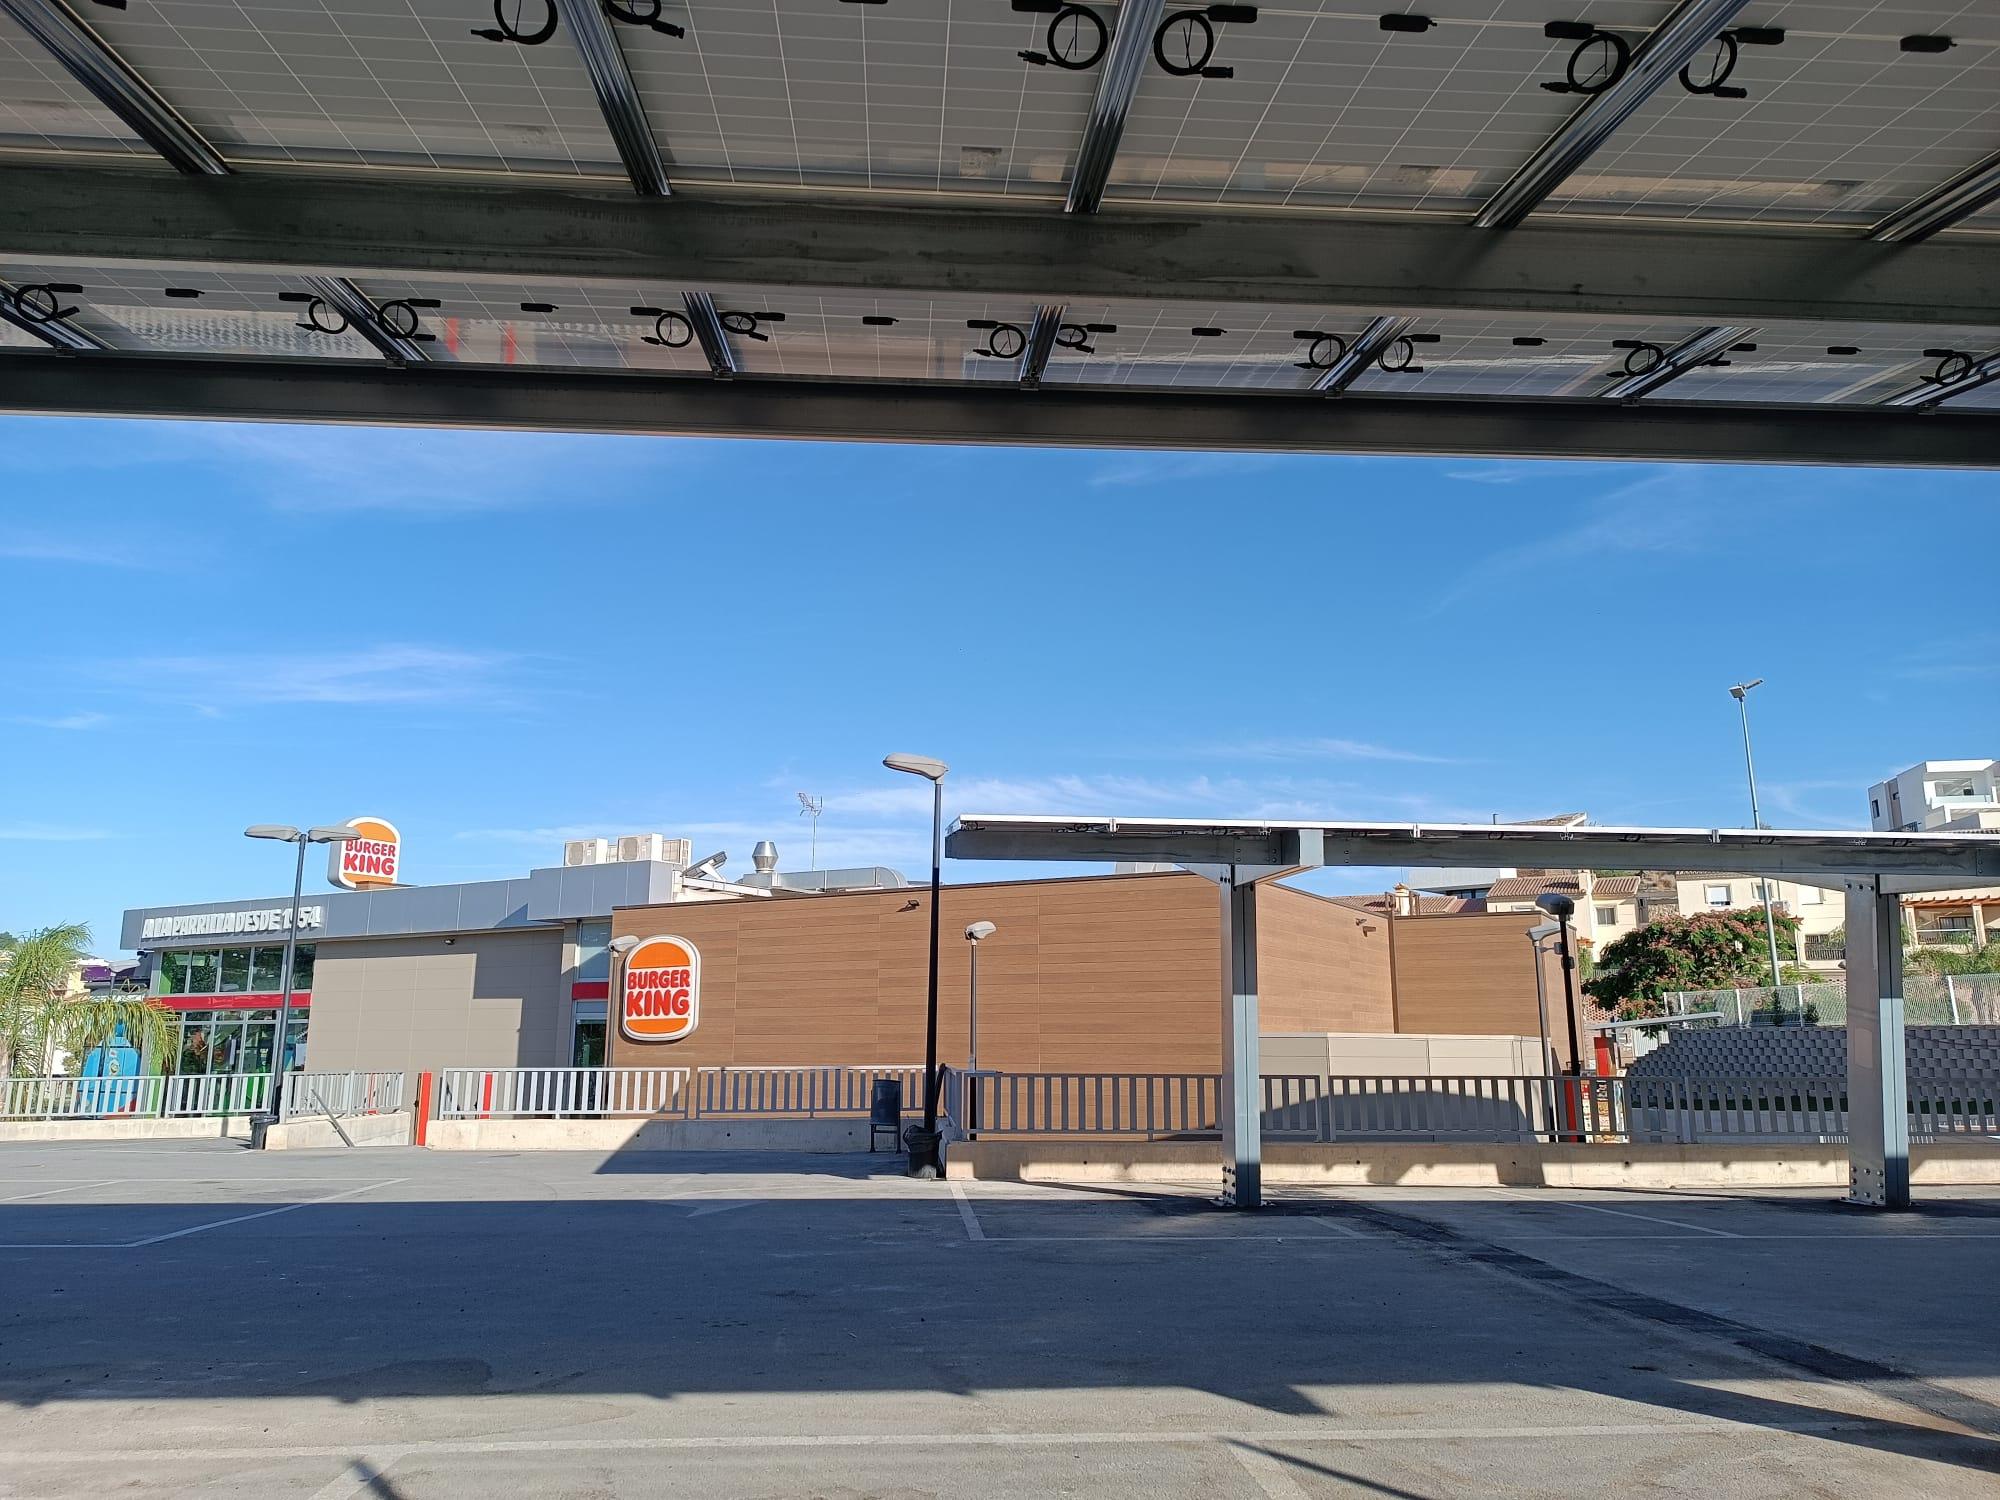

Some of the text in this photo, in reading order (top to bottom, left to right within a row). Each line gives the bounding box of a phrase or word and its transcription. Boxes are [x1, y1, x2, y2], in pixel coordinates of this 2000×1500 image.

[345, 840, 396, 857] BURGER
[343, 853, 394, 875] KING
[172, 912, 236, 936] PARRILLA
[235, 909, 282, 932] DESDE
[282, 906, 321, 929] 154
[627, 969, 691, 989] BURGER
[627, 989, 690, 1016] KING
